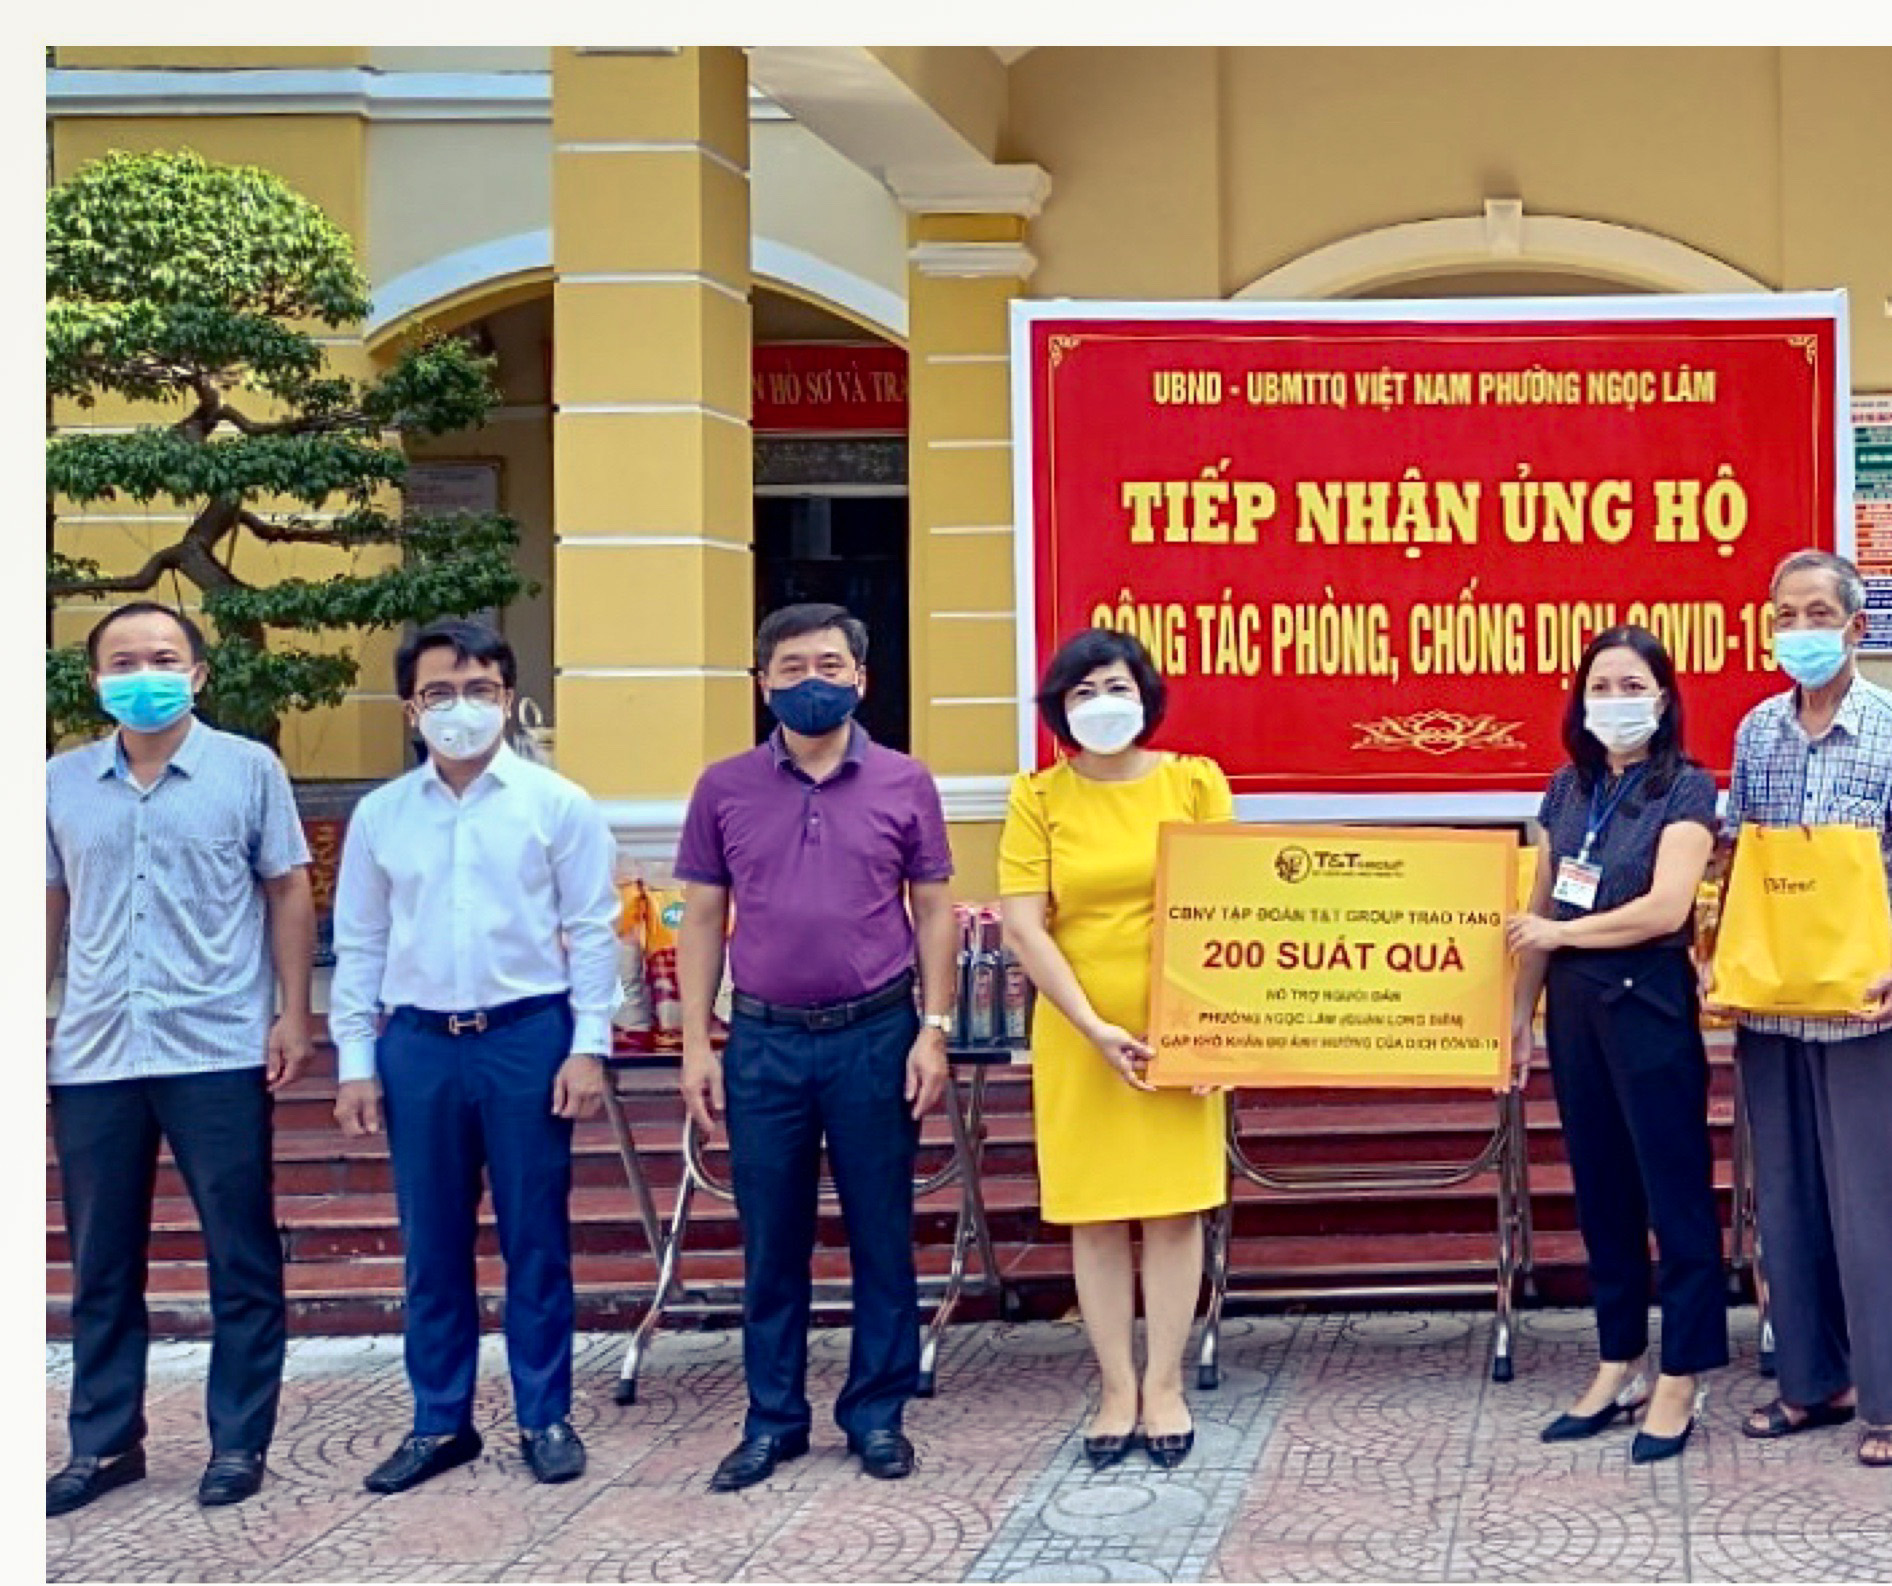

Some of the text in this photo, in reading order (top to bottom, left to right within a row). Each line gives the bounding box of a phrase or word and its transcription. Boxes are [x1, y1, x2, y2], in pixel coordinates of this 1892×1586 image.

[1153, 370, 1222, 405] UBND
[1247, 370, 1347, 409] UBMTTQ
[1354, 365, 1407, 413] VIỆT
[1414, 370, 1472, 405] NAM
[1479, 362, 1581, 405] PHƯỜNG
[1587, 370, 1656, 412] NGỌC
[1662, 363, 1717, 403] LÂM
[1121, 457, 1749, 558] TIẾP NHẬN ỦNG HỘ
[1195, 586, 1261, 675] TÁC
[1271, 584, 1399, 684] PHÒNG,
[1410, 576, 1526, 676] CHỐNG
[1346, 909, 1404, 924] GROUP
[1408, 911, 1453, 925] TRAO
[1202, 934, 1465, 973] 200 SUẤT QUÀ
